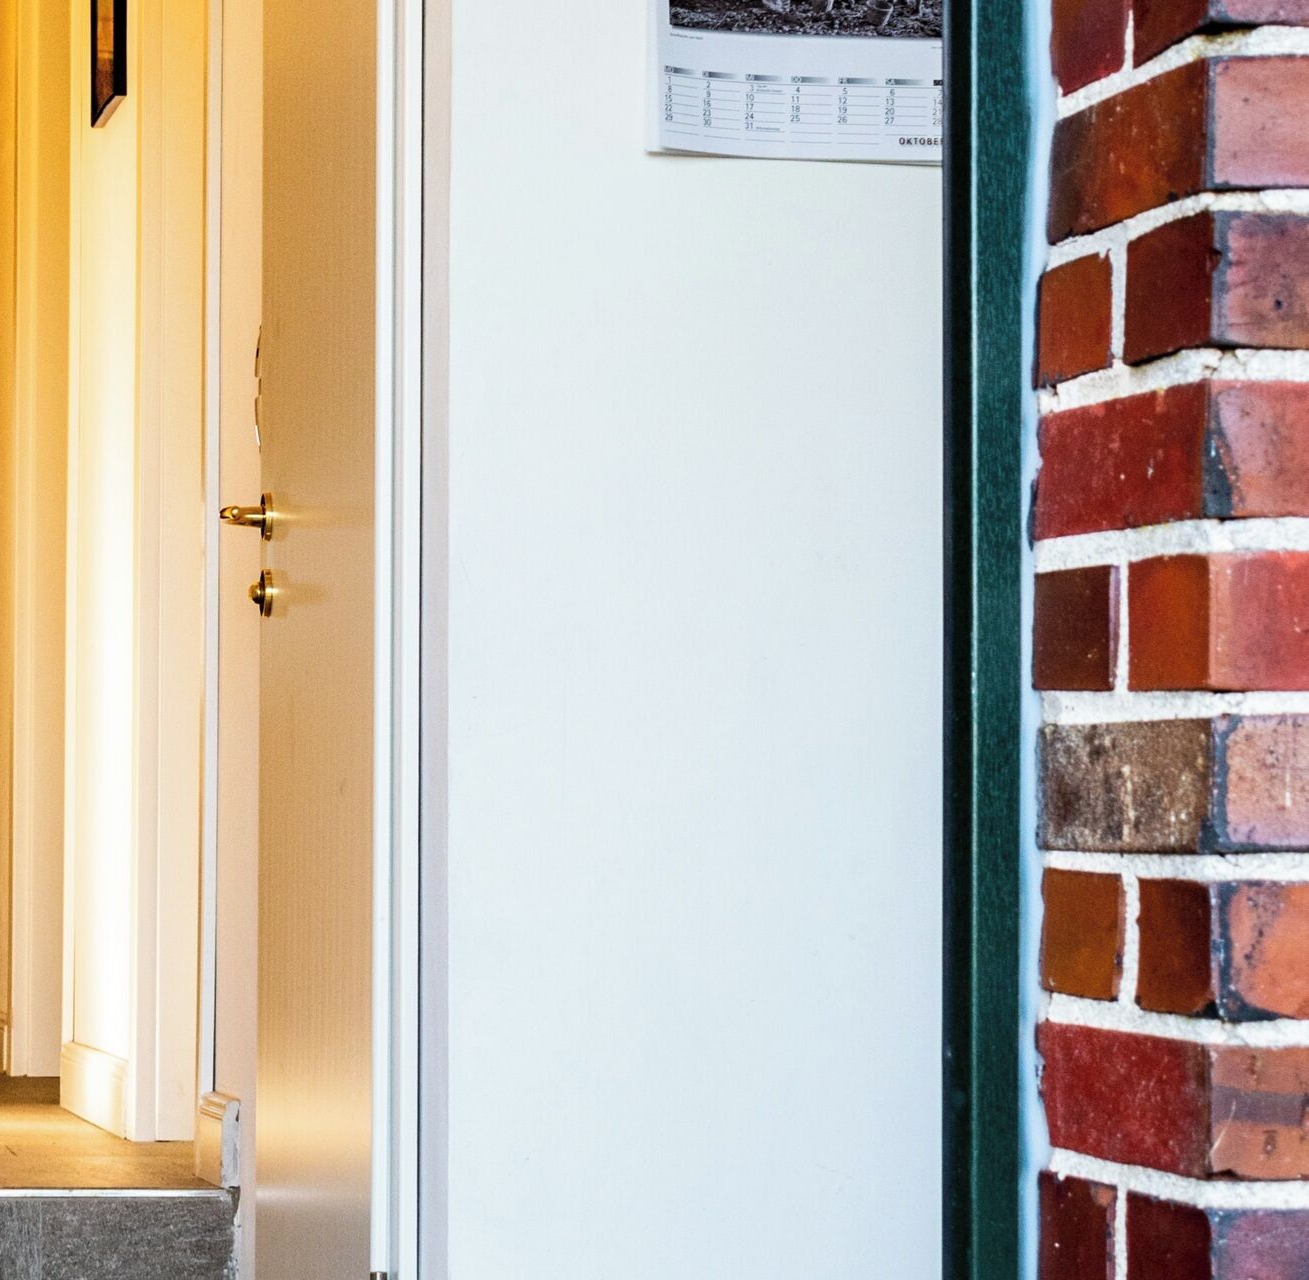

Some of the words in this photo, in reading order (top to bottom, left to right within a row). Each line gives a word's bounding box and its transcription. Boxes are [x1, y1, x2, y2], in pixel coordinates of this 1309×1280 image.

[890, 88, 895, 96] 6
[665, 104, 672, 112] 22
[838, 106, 847, 114] 19
[665, 113, 673, 121] 29
